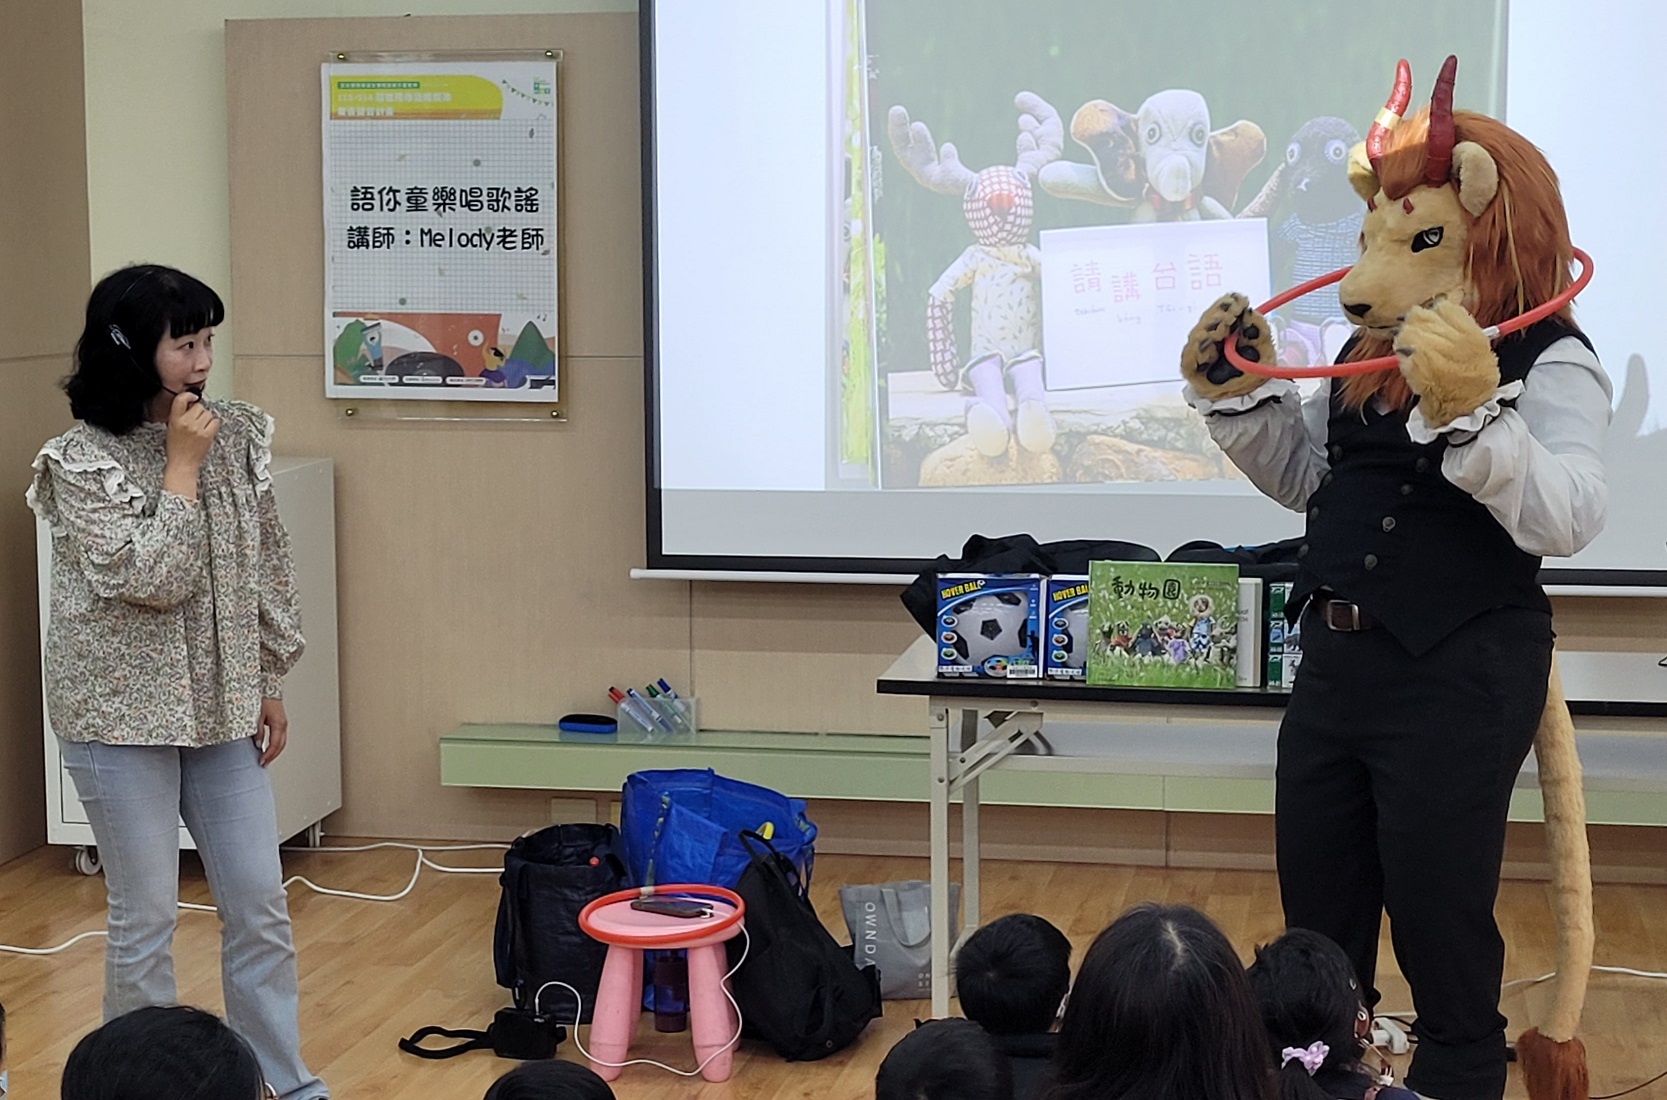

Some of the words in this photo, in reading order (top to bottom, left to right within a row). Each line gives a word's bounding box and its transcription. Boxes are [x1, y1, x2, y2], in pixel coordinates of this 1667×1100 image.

[350, 186, 539, 213] 語你童樂唱歌謠
[1070, 253, 1222, 303] 請講台語
[941, 585, 965, 599] HOVER
[1052, 587, 1076, 602] HOVER
[1111, 575, 1181, 600] 動物園
